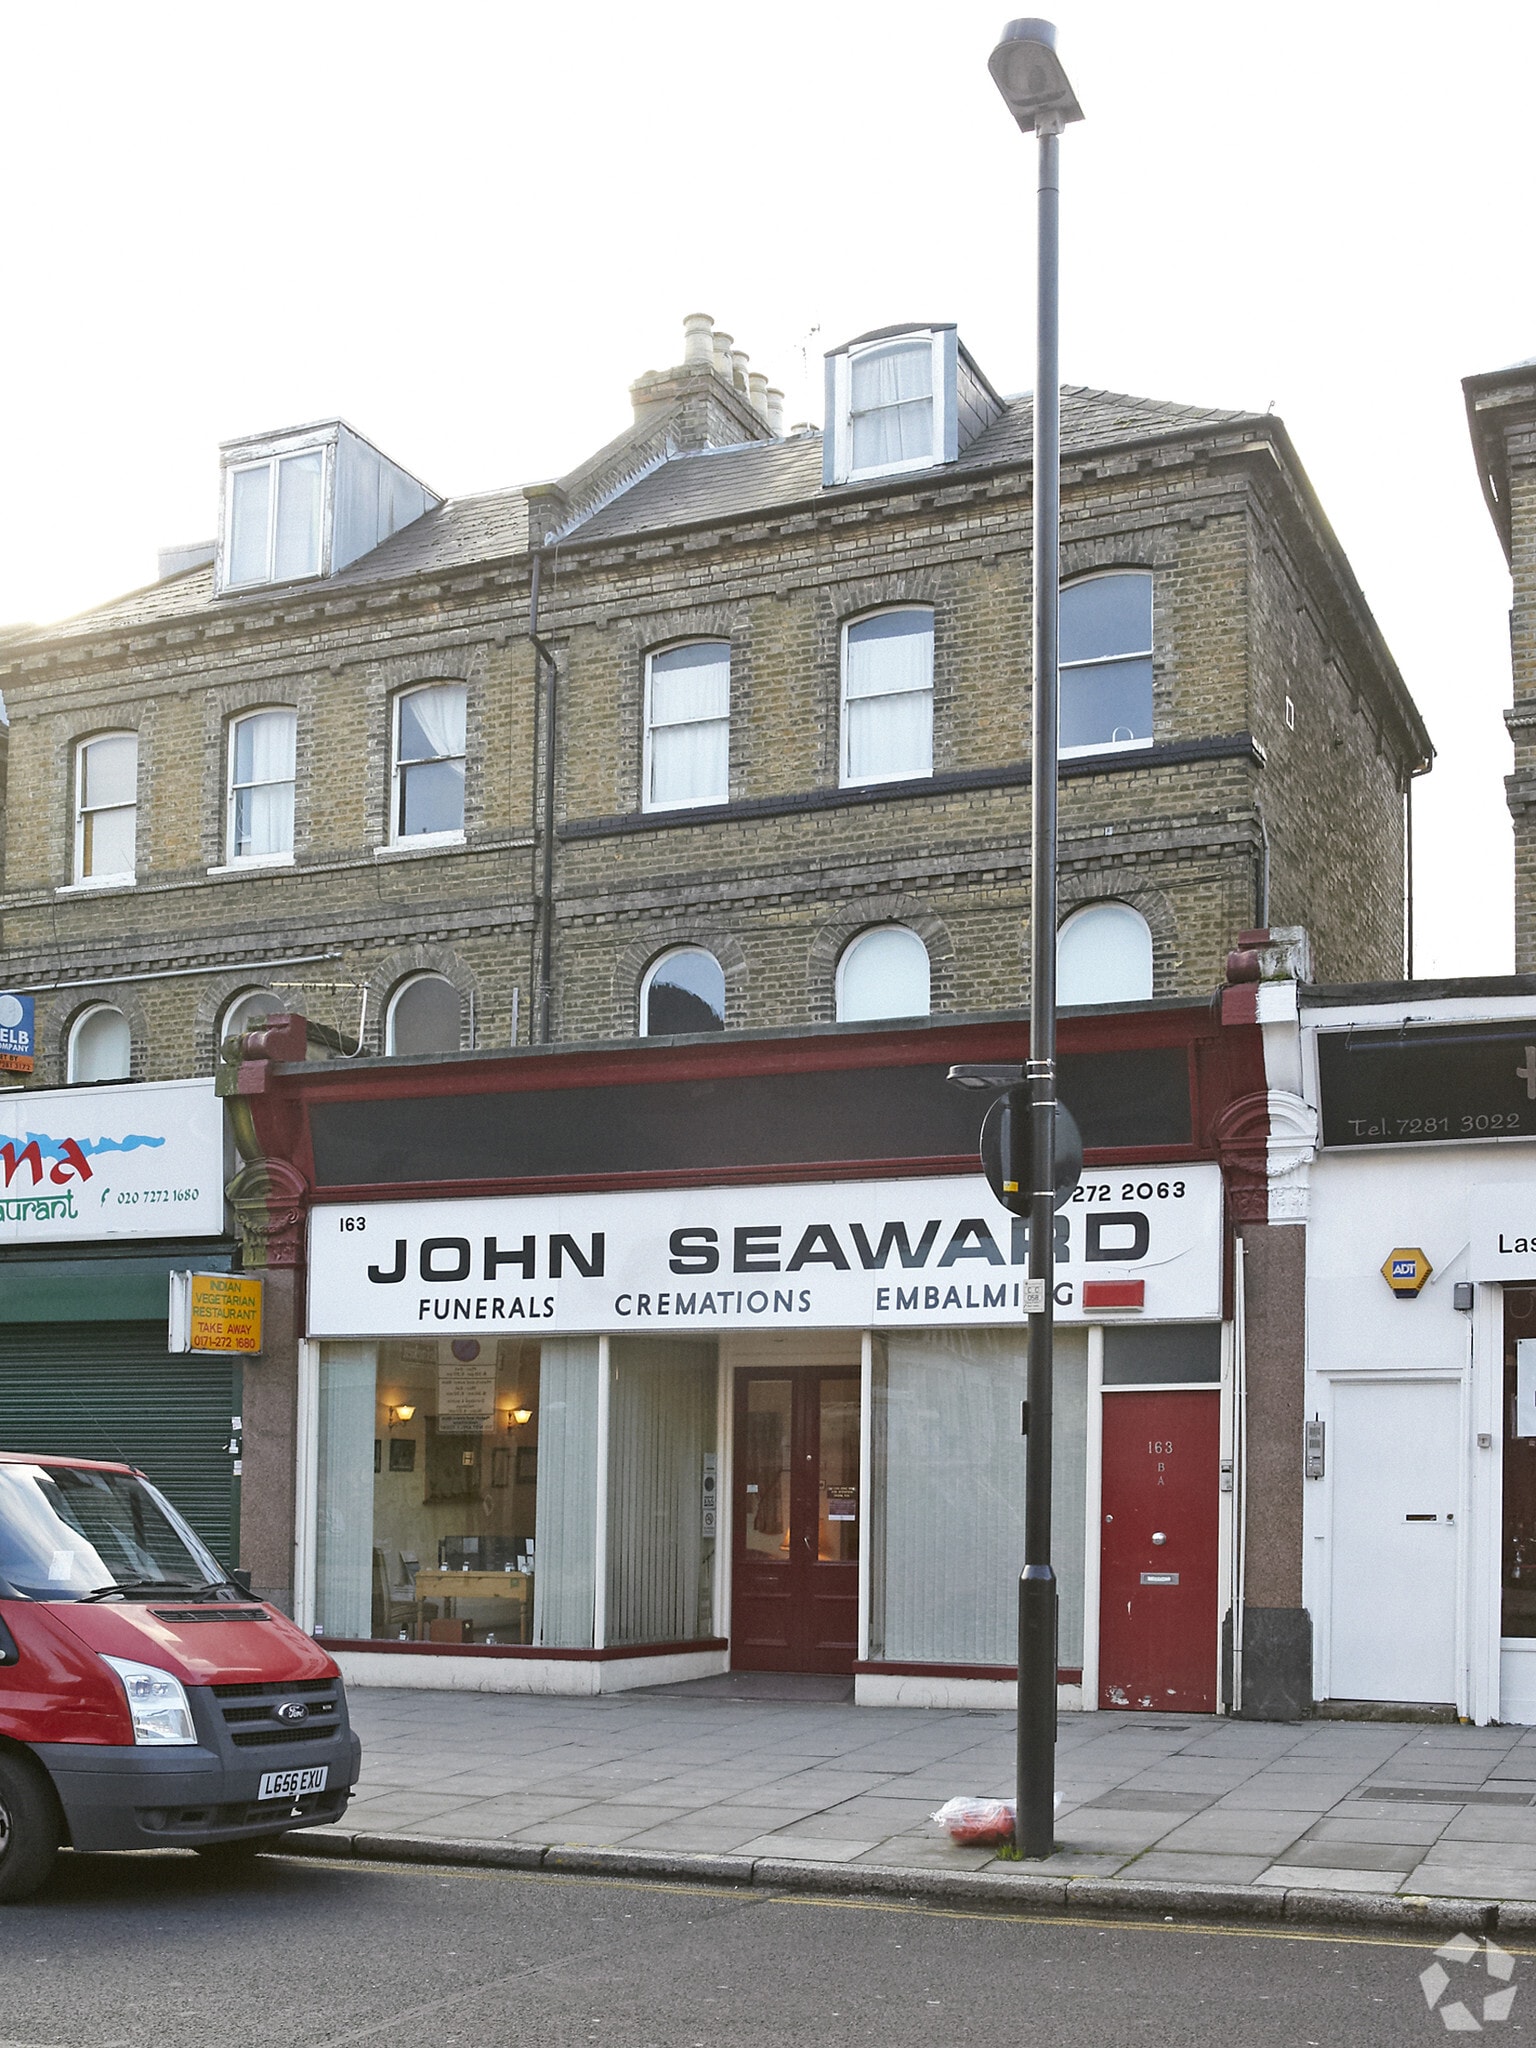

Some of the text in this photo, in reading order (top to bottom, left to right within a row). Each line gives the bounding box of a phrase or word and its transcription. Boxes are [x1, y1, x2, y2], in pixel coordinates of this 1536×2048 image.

[0, 1042, 29, 1052] MPANY
[1348, 1113, 1520, 1136] Tel. 7281 3022
[117, 1188, 200, 1205] 020 7272 1680
[1072, 1181, 1186, 1203] 272 2063
[339, 1216, 367, 1232] 163
[367, 1211, 1151, 1284] JOHN SEAWARD
[1393, 1263, 1416, 1275] ADT
[209, 1280, 242, 1293] INDIAN
[195, 1293, 257, 1307] VEGETARIAN
[418, 1296, 555, 1321] FUNERALS
[614, 1289, 812, 1317] CREMATIONS
[876, 1281, 1074, 1312] EMBALMIG
[193, 1305, 257, 1320] RESTAURANT
[198, 1321, 252, 1335] TAKE AWAY
[194, 1335, 256, 1349] 0171-272 1680
[1148, 1441, 1173, 1454] 163
[288, 1705, 305, 1717] Ford
[300, 1769, 324, 1790] EXU
